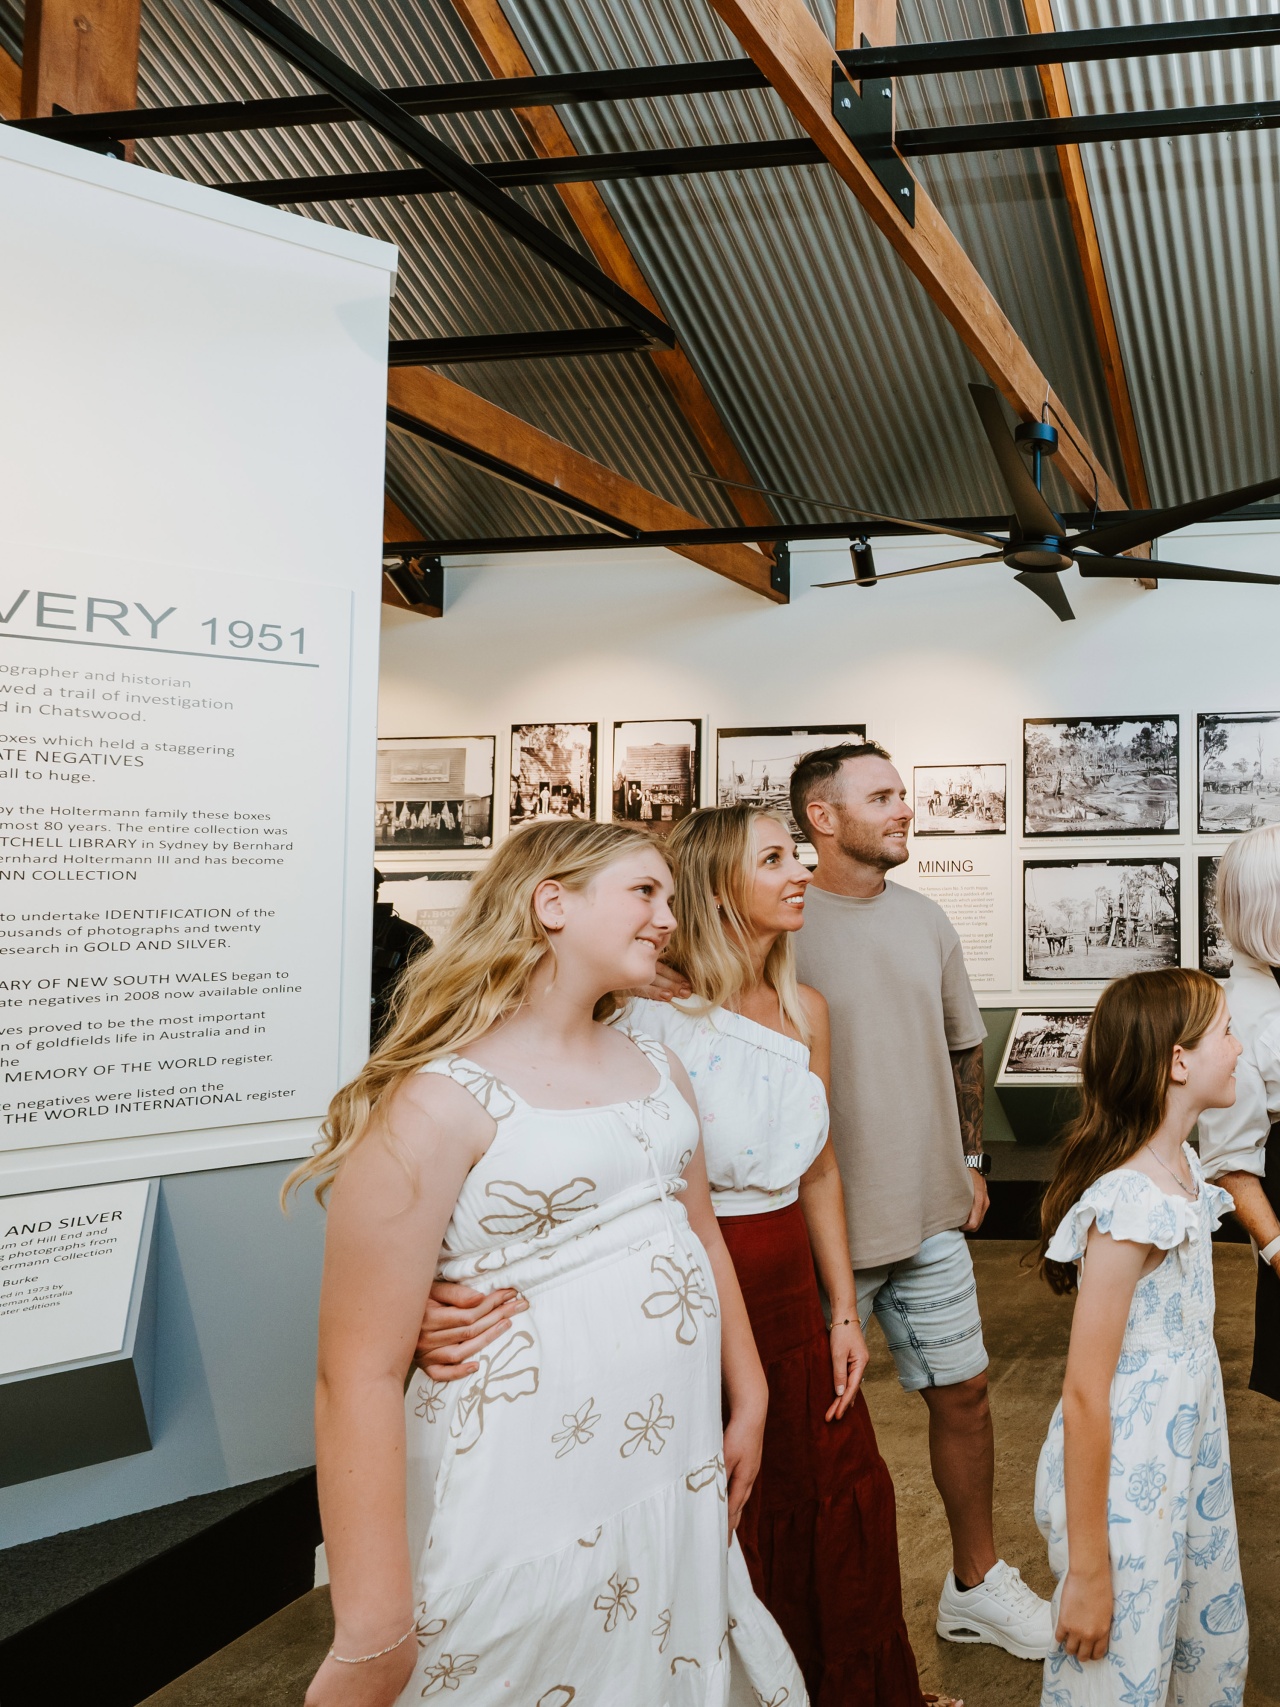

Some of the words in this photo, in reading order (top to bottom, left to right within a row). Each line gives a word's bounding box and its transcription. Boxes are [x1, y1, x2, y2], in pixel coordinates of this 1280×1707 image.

[201, 617, 306, 654] 1951
[85, 672, 115, 682] and
[122, 673, 190, 688] historian
[44, 688, 52, 696] a
[60, 688, 95, 699] trail
[102, 690, 120, 701] of
[126, 692, 233, 710] investigation
[16, 702, 31, 714] in
[39, 704, 146, 721] Chatswood.
[43, 736, 92, 747] which
[100, 738, 134, 749] held
[155, 743, 234, 757] staggering
[36, 751, 144, 767] NEGATIVES
[20, 805, 44, 814] the
[51, 807, 139, 816] Holtermann
[145, 809, 187, 820] family
[193, 810, 229, 819] these
[234, 811, 270, 820] boxes
[70, 838, 136, 848] LIBRARY
[142, 840, 154, 848] in
[159, 840, 208, 851] Sydney
[214, 841, 228, 851] by
[234, 842, 292, 850] Bernhard
[918, 860, 974, 872] MINING
[22, 911, 99, 921] undertake
[106, 909, 230, 919] IDENTIFICATION
[237, 909, 250, 917] of
[254, 909, 275, 917] the
[66, 944, 78, 952] in
[84, 942, 130, 952] GOLD
[136, 940, 171, 950] AND
[177, 939, 230, 949] SILVER.
[38, 979, 60, 989] OF
[68, 977, 108, 988] NEW
[114, 974, 169, 986] SOUTH
[176, 972, 227, 982] WALES
[232, 972, 271, 982] began
[6, 1067, 88, 1082] MEMORY
[94, 1065, 115, 1075] OF
[121, 1062, 152, 1073] THE
[158, 1057, 216, 1070] WORLD
[222, 1055, 272, 1066] register.
[4, 1112, 37, 1124] THE
[44, 1106, 108, 1120] WORLD
[116, 1093, 242, 1113] INTERNATIONAL
[247, 1090, 296, 1101] register
[5, 1221, 51, 1237] AND
[59, 1210, 122, 1229] SILVER
[37, 1236, 56, 1244] Hill
[61, 1232, 82, 1240] End
[86, 1228, 107, 1236] and
[9, 1243, 85, 1260] photographs
[90, 1238, 116, 1246] from
[0, 1259, 49, 1270] ermann
[54, 1249, 112, 1262] Collection
[3, 1276, 38, 1286] Burke
